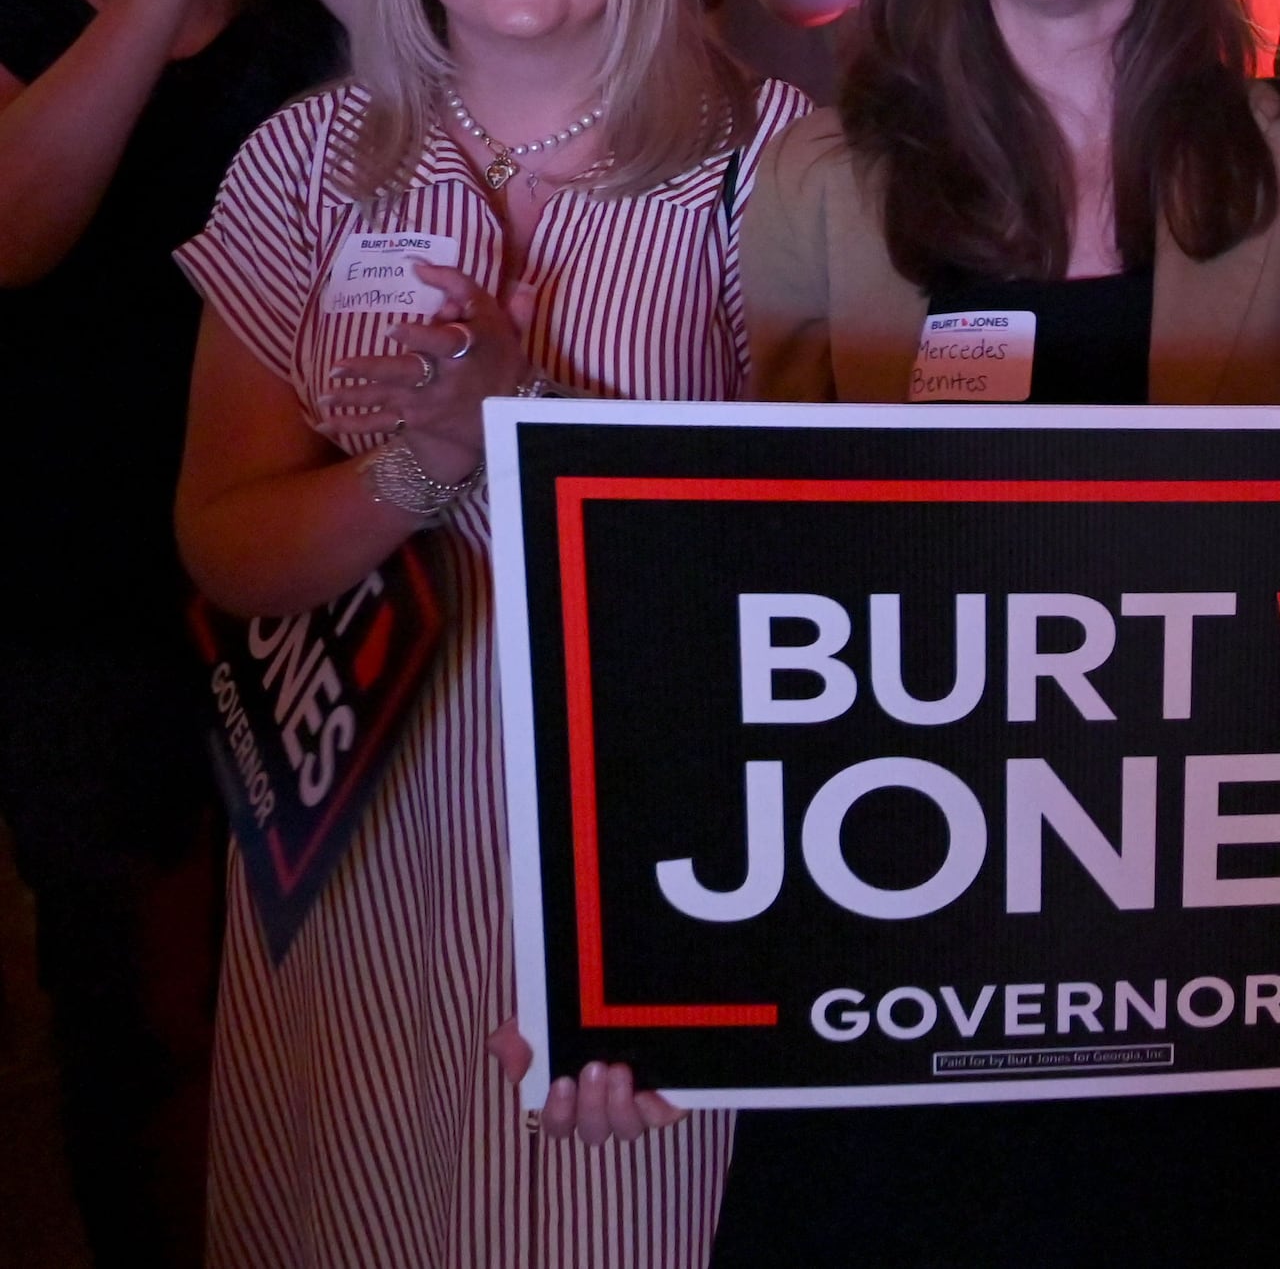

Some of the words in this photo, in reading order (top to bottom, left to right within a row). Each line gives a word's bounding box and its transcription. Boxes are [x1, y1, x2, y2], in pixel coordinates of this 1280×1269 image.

[360, 239, 388, 249] BURT
[394, 238, 431, 249] JONES
[347, 261, 405, 281] Emma
[931, 318, 960, 330] BURT
[969, 317, 1009, 328] JONES
[920, 338, 1008, 362] Mercedes
[738, 591, 1236, 725] BURT
[210, 661, 277, 828] GOVERNOR
[939, 1056, 967, 1068] Paid
[968, 1055, 986, 1067] for
[989, 1056, 1005, 1069] by
[1007, 1053, 1034, 1066] Burt
[1036, 1052, 1071, 1065] Jones
[1073, 1051, 1090, 1063] for
